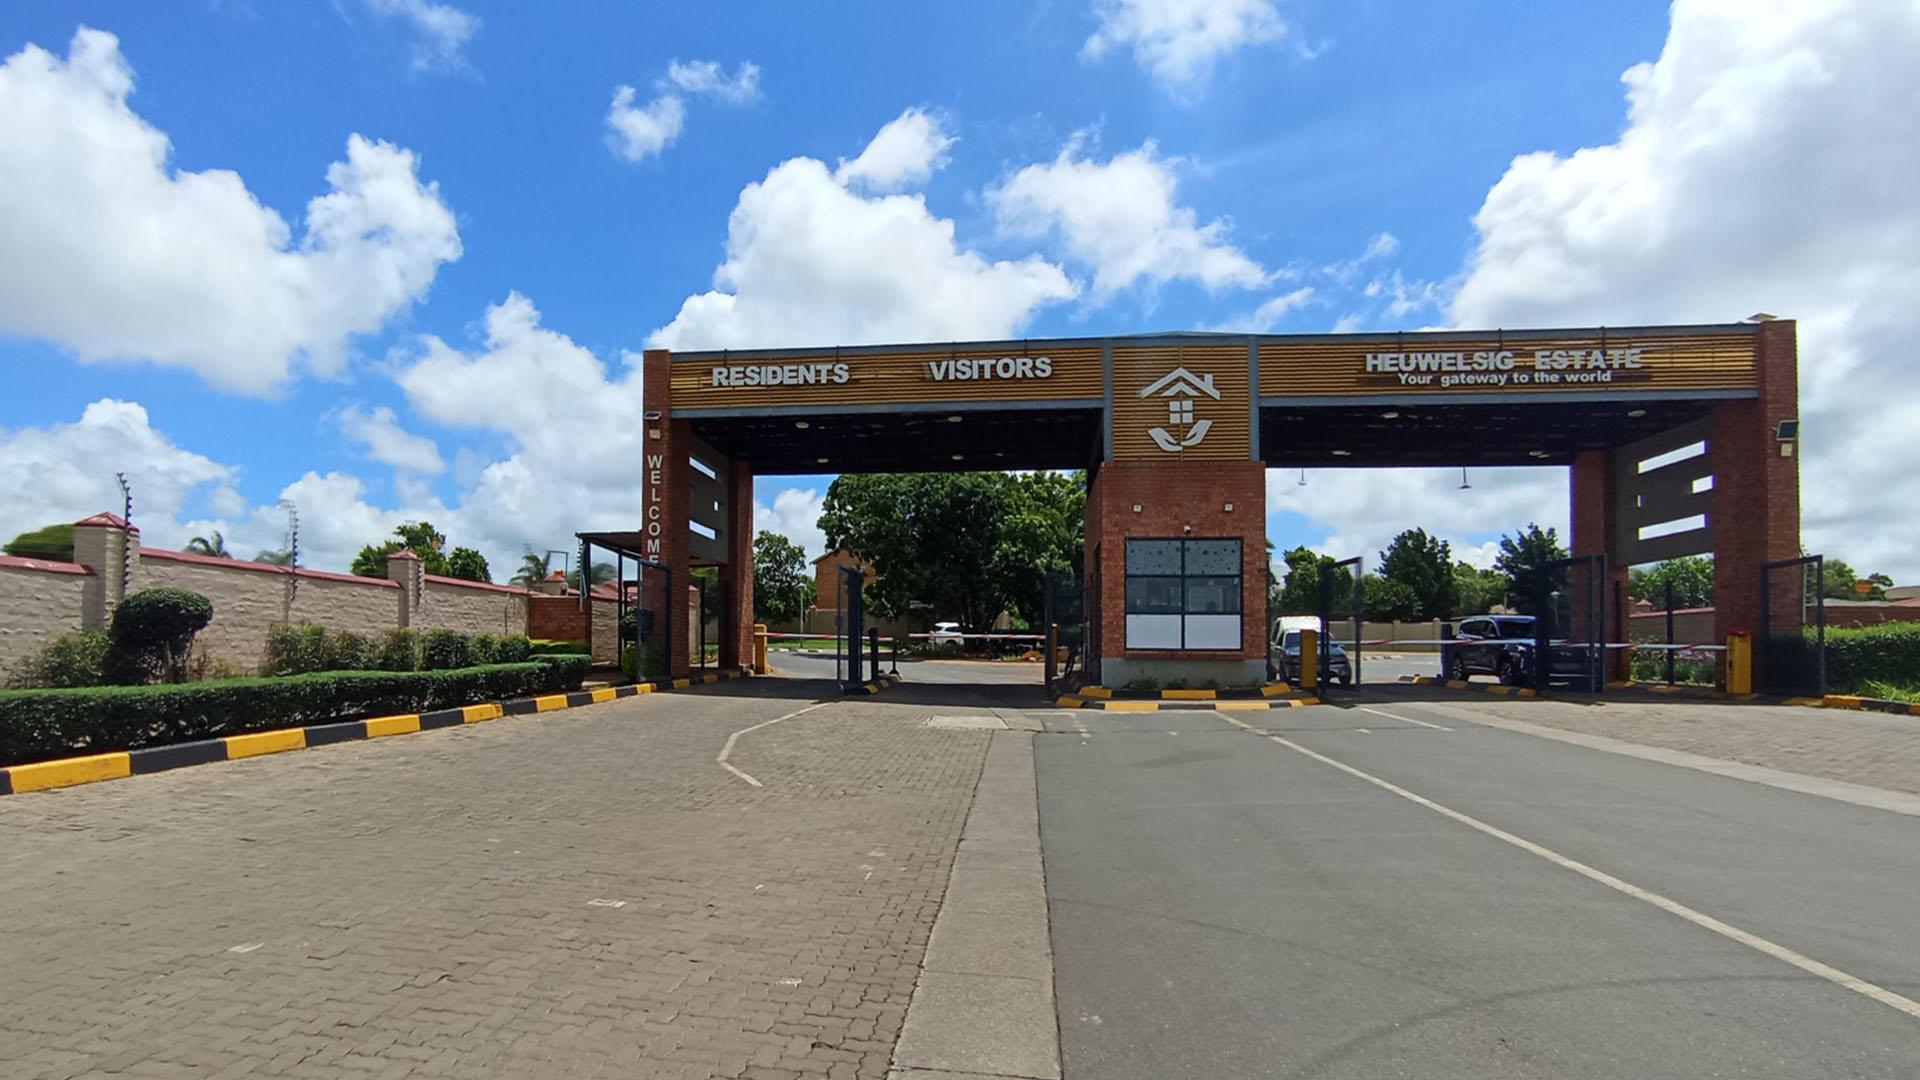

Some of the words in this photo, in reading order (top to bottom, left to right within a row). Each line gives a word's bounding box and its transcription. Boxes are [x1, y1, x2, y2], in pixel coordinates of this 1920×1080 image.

[928, 357, 1053, 381] VISITORS
[1365, 351, 1515, 373] HEUWELSIG
[1534, 349, 1643, 370] ESTATE
[712, 363, 850, 387] RESIDENTS
[1398, 372, 1433, 385] Your
[1440, 372, 1508, 388] gateway
[1512, 371, 1529, 384] to
[1533, 371, 1560, 383] the
[1564, 370, 1612, 383] world
